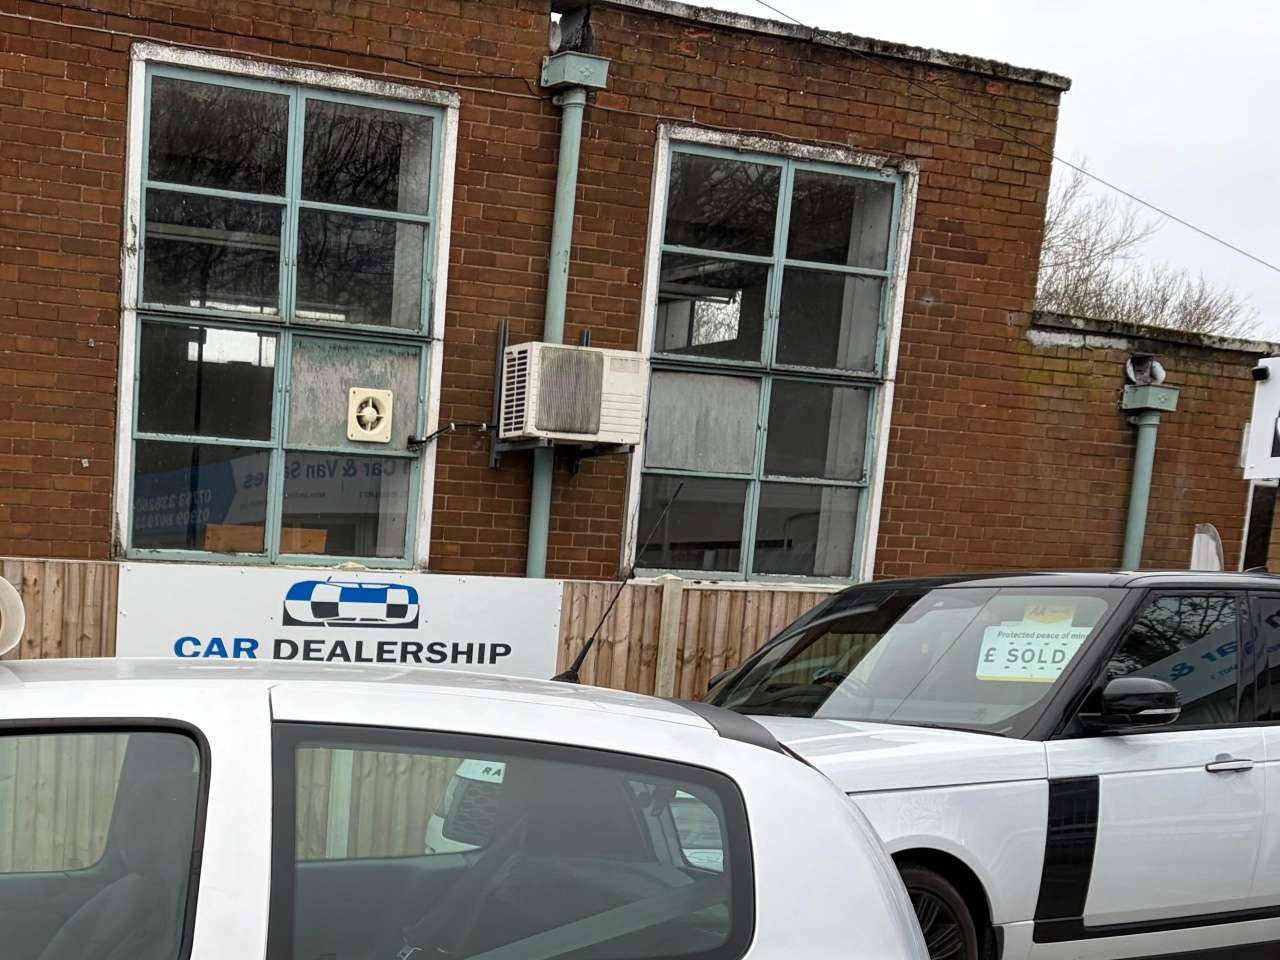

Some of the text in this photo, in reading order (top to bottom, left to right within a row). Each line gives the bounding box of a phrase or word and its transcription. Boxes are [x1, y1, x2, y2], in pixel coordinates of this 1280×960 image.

[997, 631, 1035, 640] Protected
[1036, 632, 1060, 642] peace
[1071, 632, 1090, 640] min
[173, 636, 513, 665] CAR DEALERSHIP
[983, 647, 1066, 665] £ SOLD
